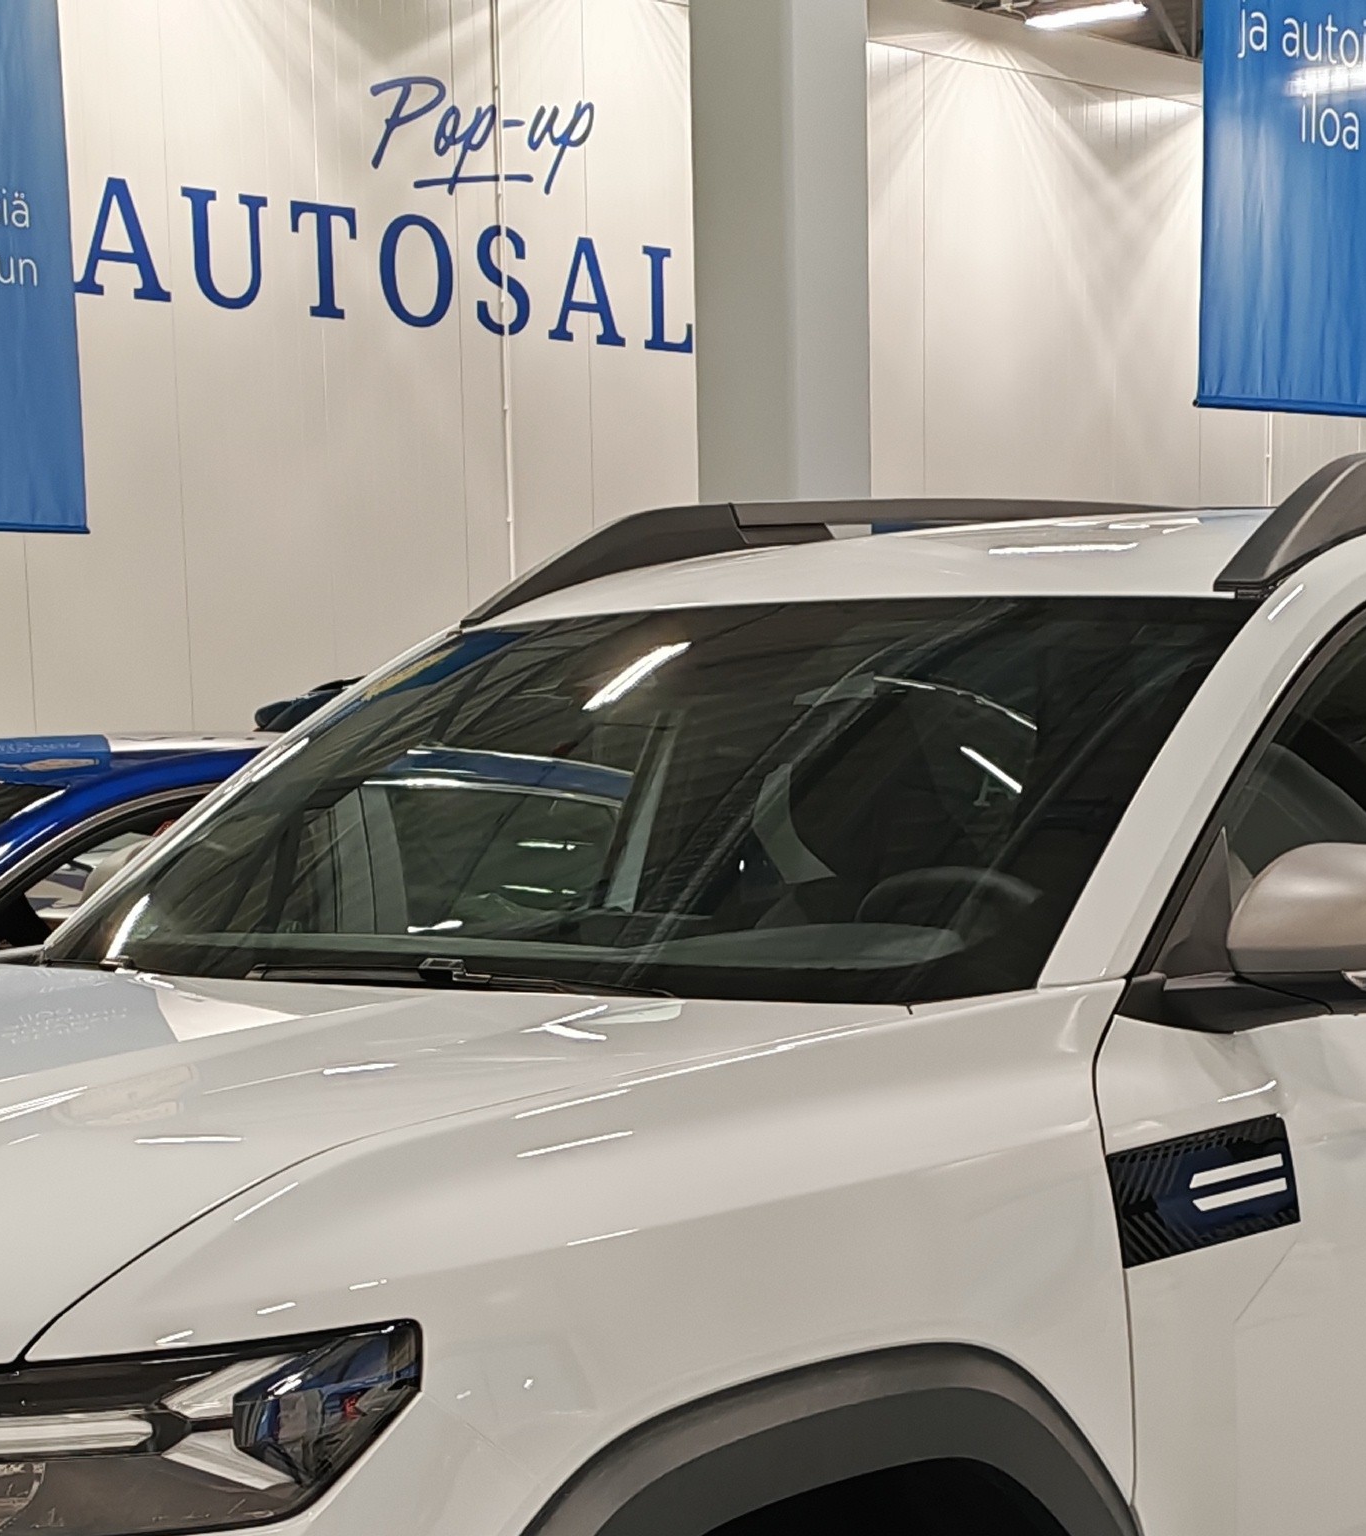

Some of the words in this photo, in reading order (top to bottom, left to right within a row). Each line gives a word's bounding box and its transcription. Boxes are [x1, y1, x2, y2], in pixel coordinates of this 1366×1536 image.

[1237, 0, 1268, 59] ja
[370, 75, 595, 195] Pop-up
[1300, 91, 1360, 150] iloa
[75, 176, 693, 354] AUTOSAL
